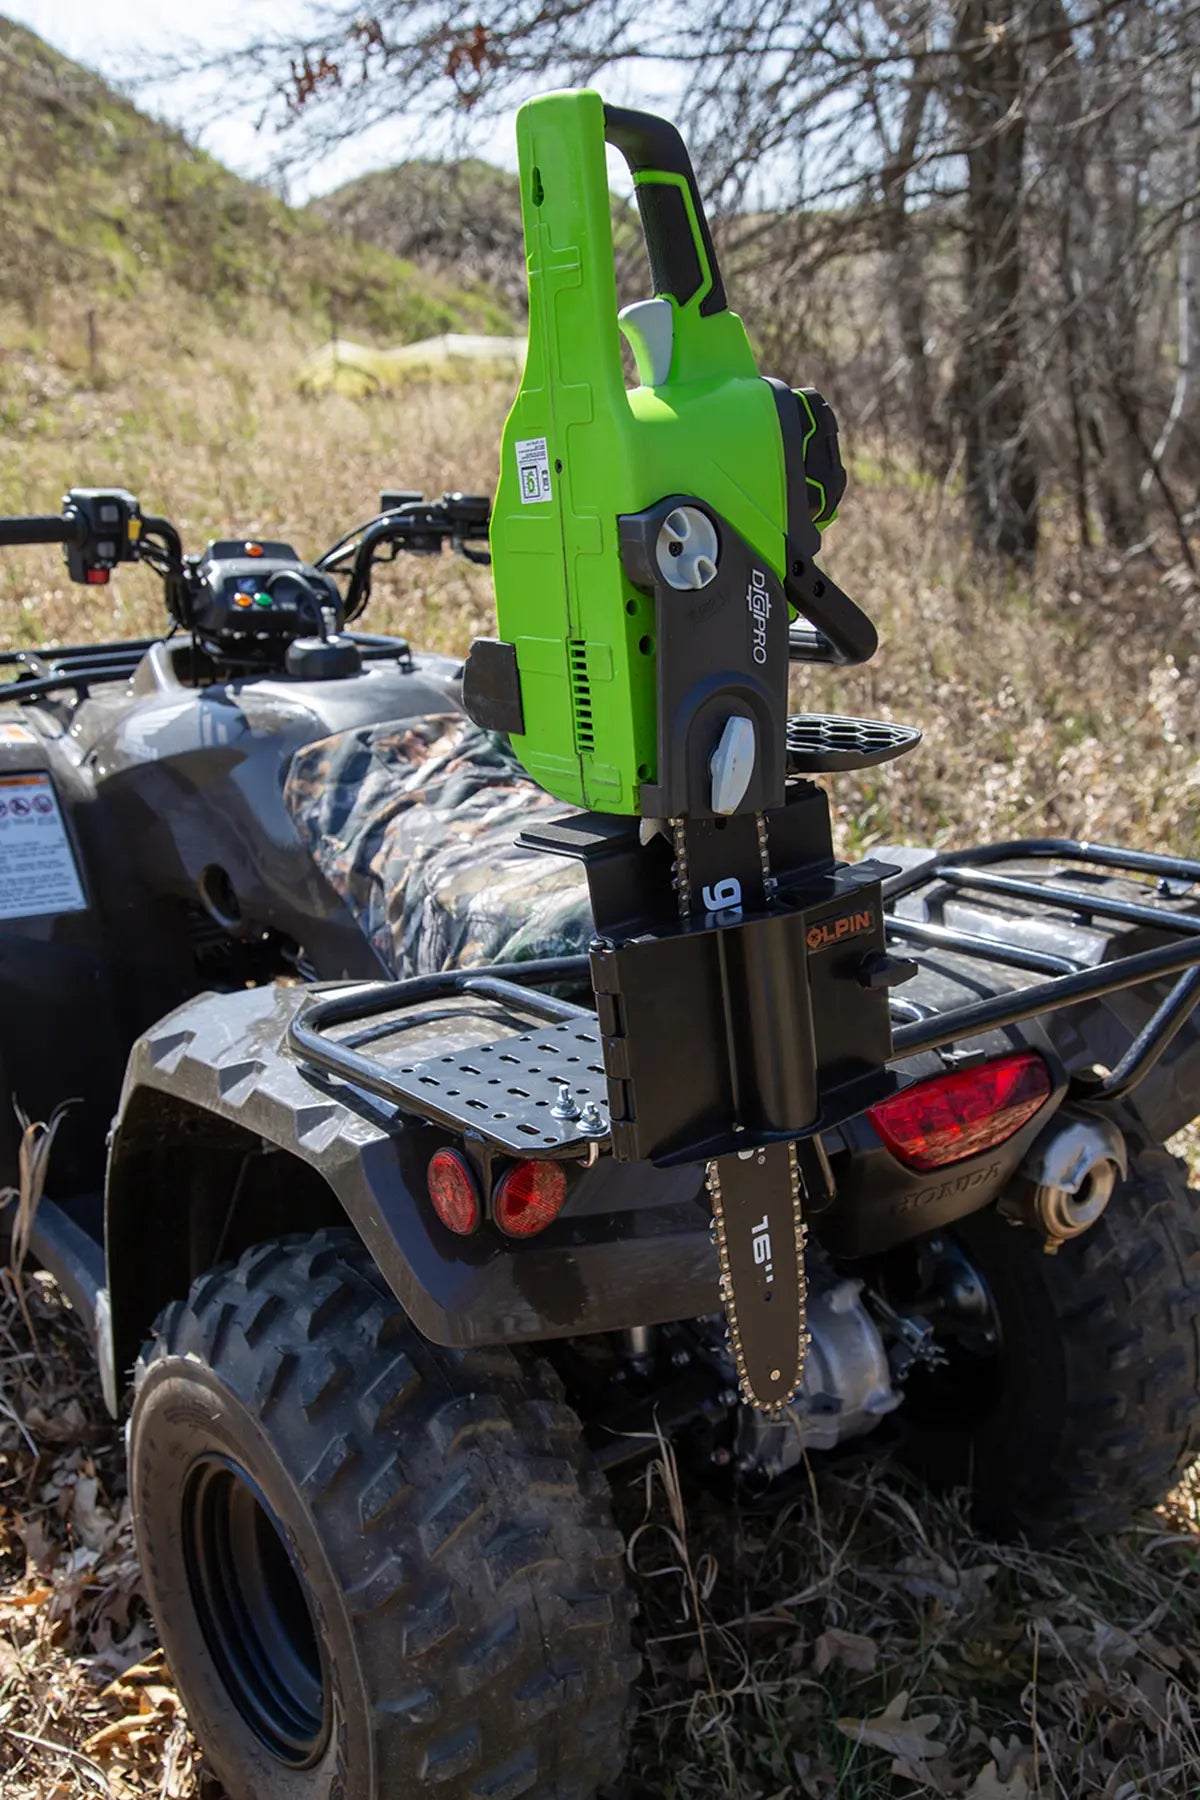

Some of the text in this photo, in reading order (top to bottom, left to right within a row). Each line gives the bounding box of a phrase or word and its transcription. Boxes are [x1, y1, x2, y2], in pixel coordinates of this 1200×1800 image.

[748, 568, 770, 664] DIGIPRO
[806, 910, 870, 948] OLPIN
[892, 1160, 1002, 1215] HONDA
